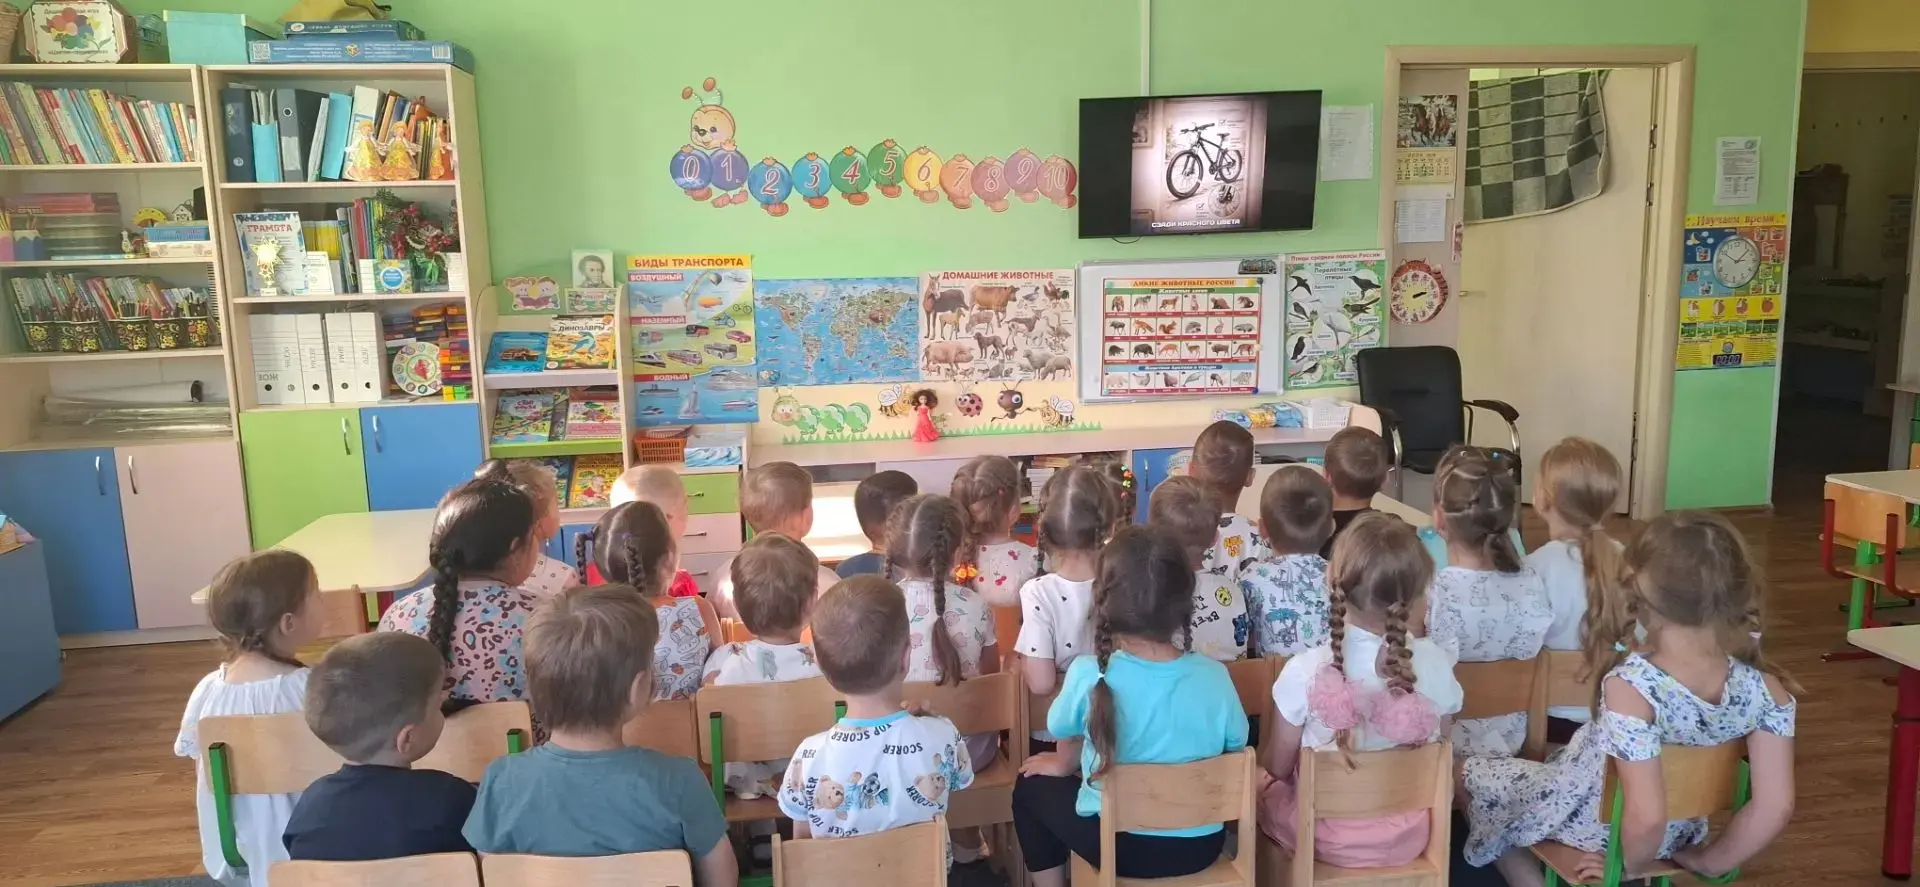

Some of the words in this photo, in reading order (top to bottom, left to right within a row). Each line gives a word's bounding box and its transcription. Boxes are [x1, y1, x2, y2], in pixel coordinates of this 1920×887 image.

[682, 155, 700, 182] 0
[721, 153, 733, 182] 1
[761, 168, 781, 195] 2
[804, 162, 822, 188] 3
[841, 159, 862, 185] 4
[879, 151, 900, 176] 5
[917, 157, 932, 182] 6
[953, 166, 969, 189] 7
[983, 165, 1001, 193] 8
[1015, 158, 1034, 185] 9
[1043, 166, 1070, 190] 10
[1177, 219, 1216, 228] КРАСНОГО
[1216, 218, 1241, 226] ЦВЕТА
[247, 224, 293, 233] ГРАМОТА
[634, 258, 668, 268] ВИДЫ
[671, 258, 744, 268] ТРАНСПОРТА
[630, 273, 682, 281] ВОЗДУШНЫЙ
[942, 271, 999, 280] ДОМАШНИЕ
[1000, 271, 1054, 280] ЖИВОТНЫЕ
[1161, 279, 1204, 287] ЖИВОТНЫЕ
[641, 316, 686, 325] НАЗЕМНЫЙ
[557, 323, 605, 332] ДИНОЗАВРЫ
[653, 373, 689, 382] ВОДНЫЙ
[1191, 611, 1220, 628] BREA
[831, 730, 871, 742] SCORER
[882, 742, 924, 756] SCORER
